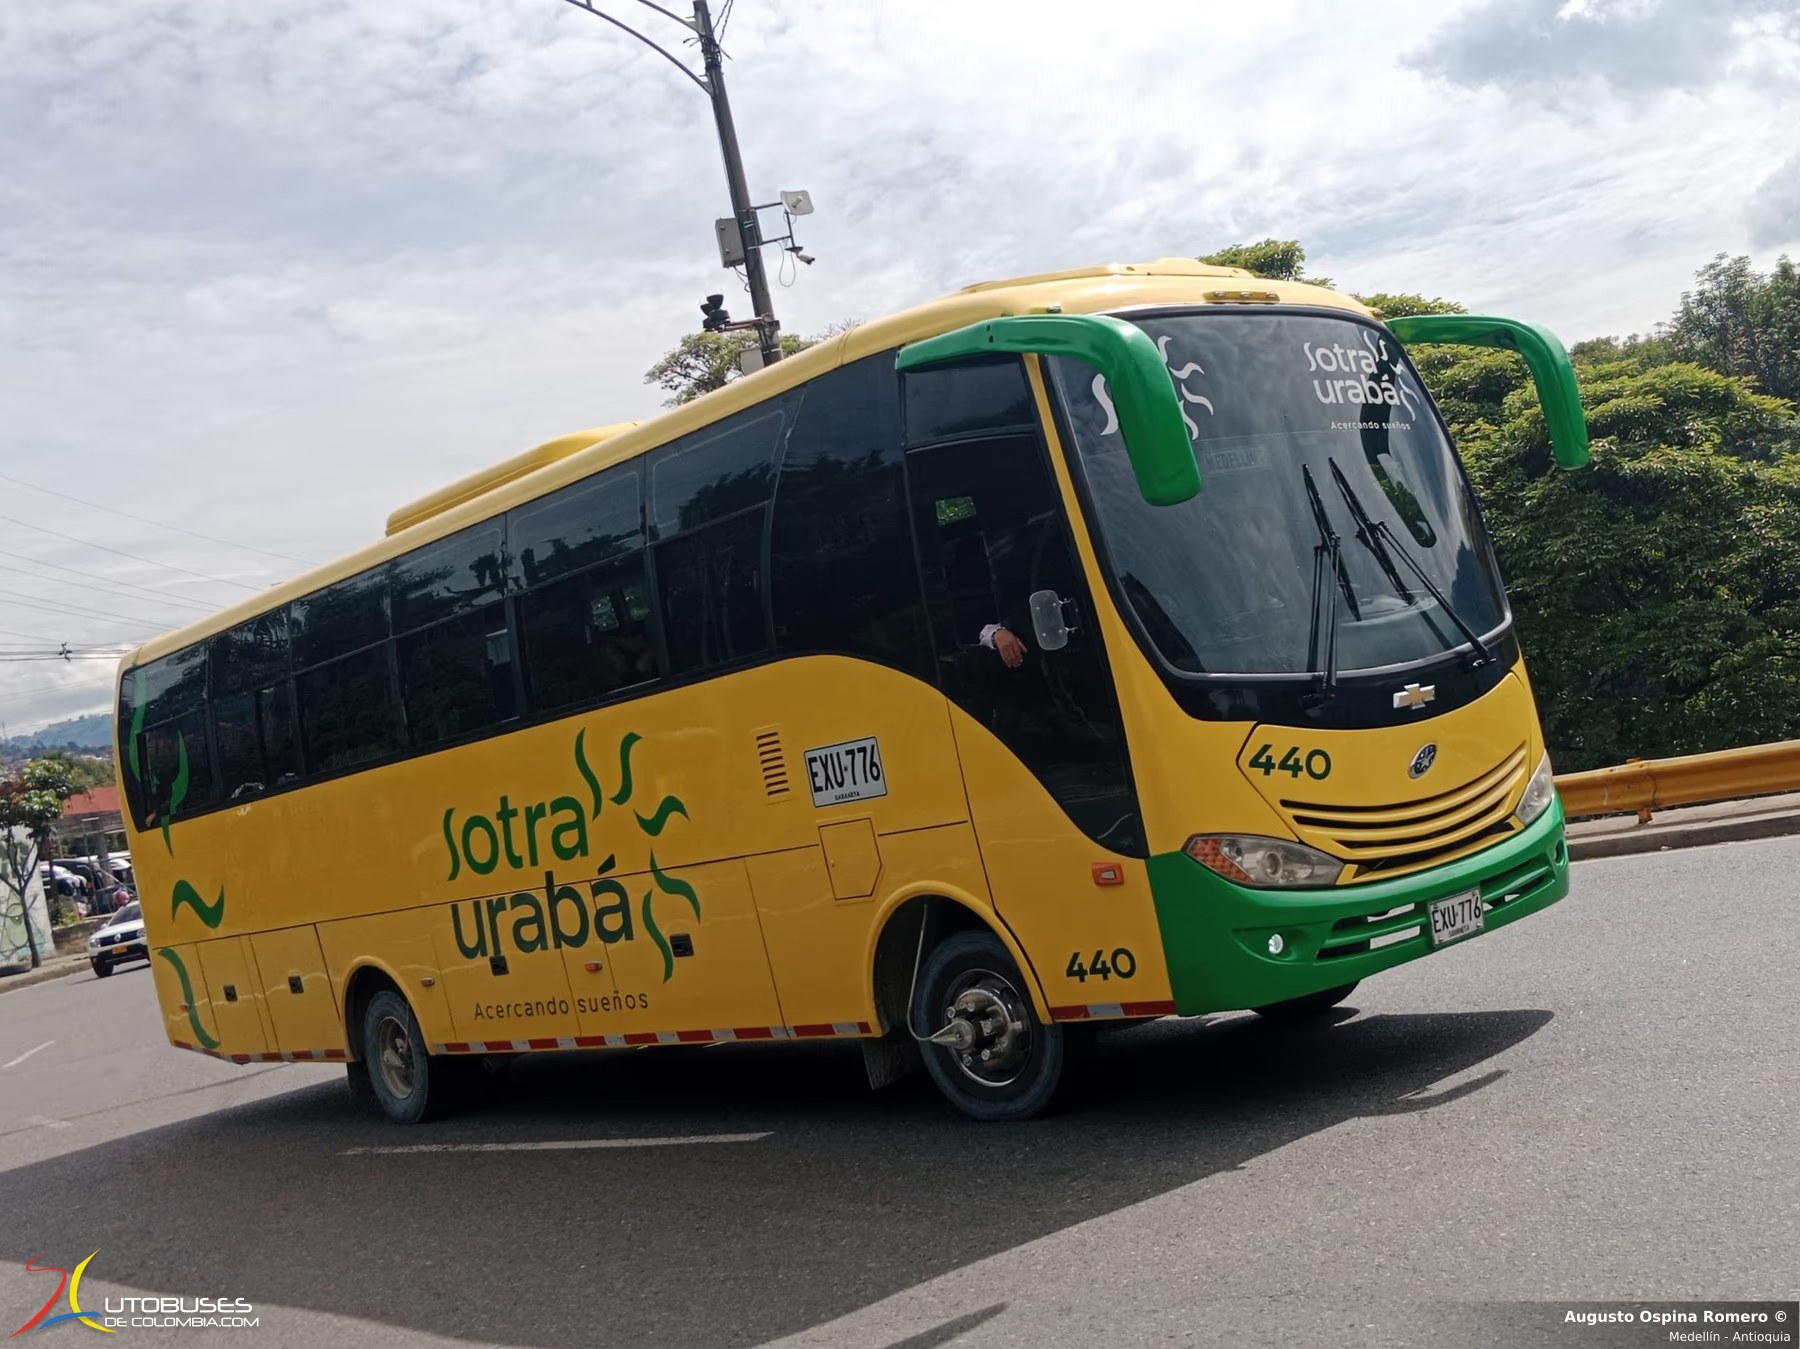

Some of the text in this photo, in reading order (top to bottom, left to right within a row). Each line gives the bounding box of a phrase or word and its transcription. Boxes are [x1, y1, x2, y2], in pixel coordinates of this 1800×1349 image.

[1313, 373, 1400, 405] urabá
[1331, 421, 1411, 430] Acercando sueños
[1248, 743, 1332, 780] 440
[451, 853, 634, 959] urabá
[1065, 947, 1136, 983] 440
[474, 990, 649, 1020] Acercando sueños
